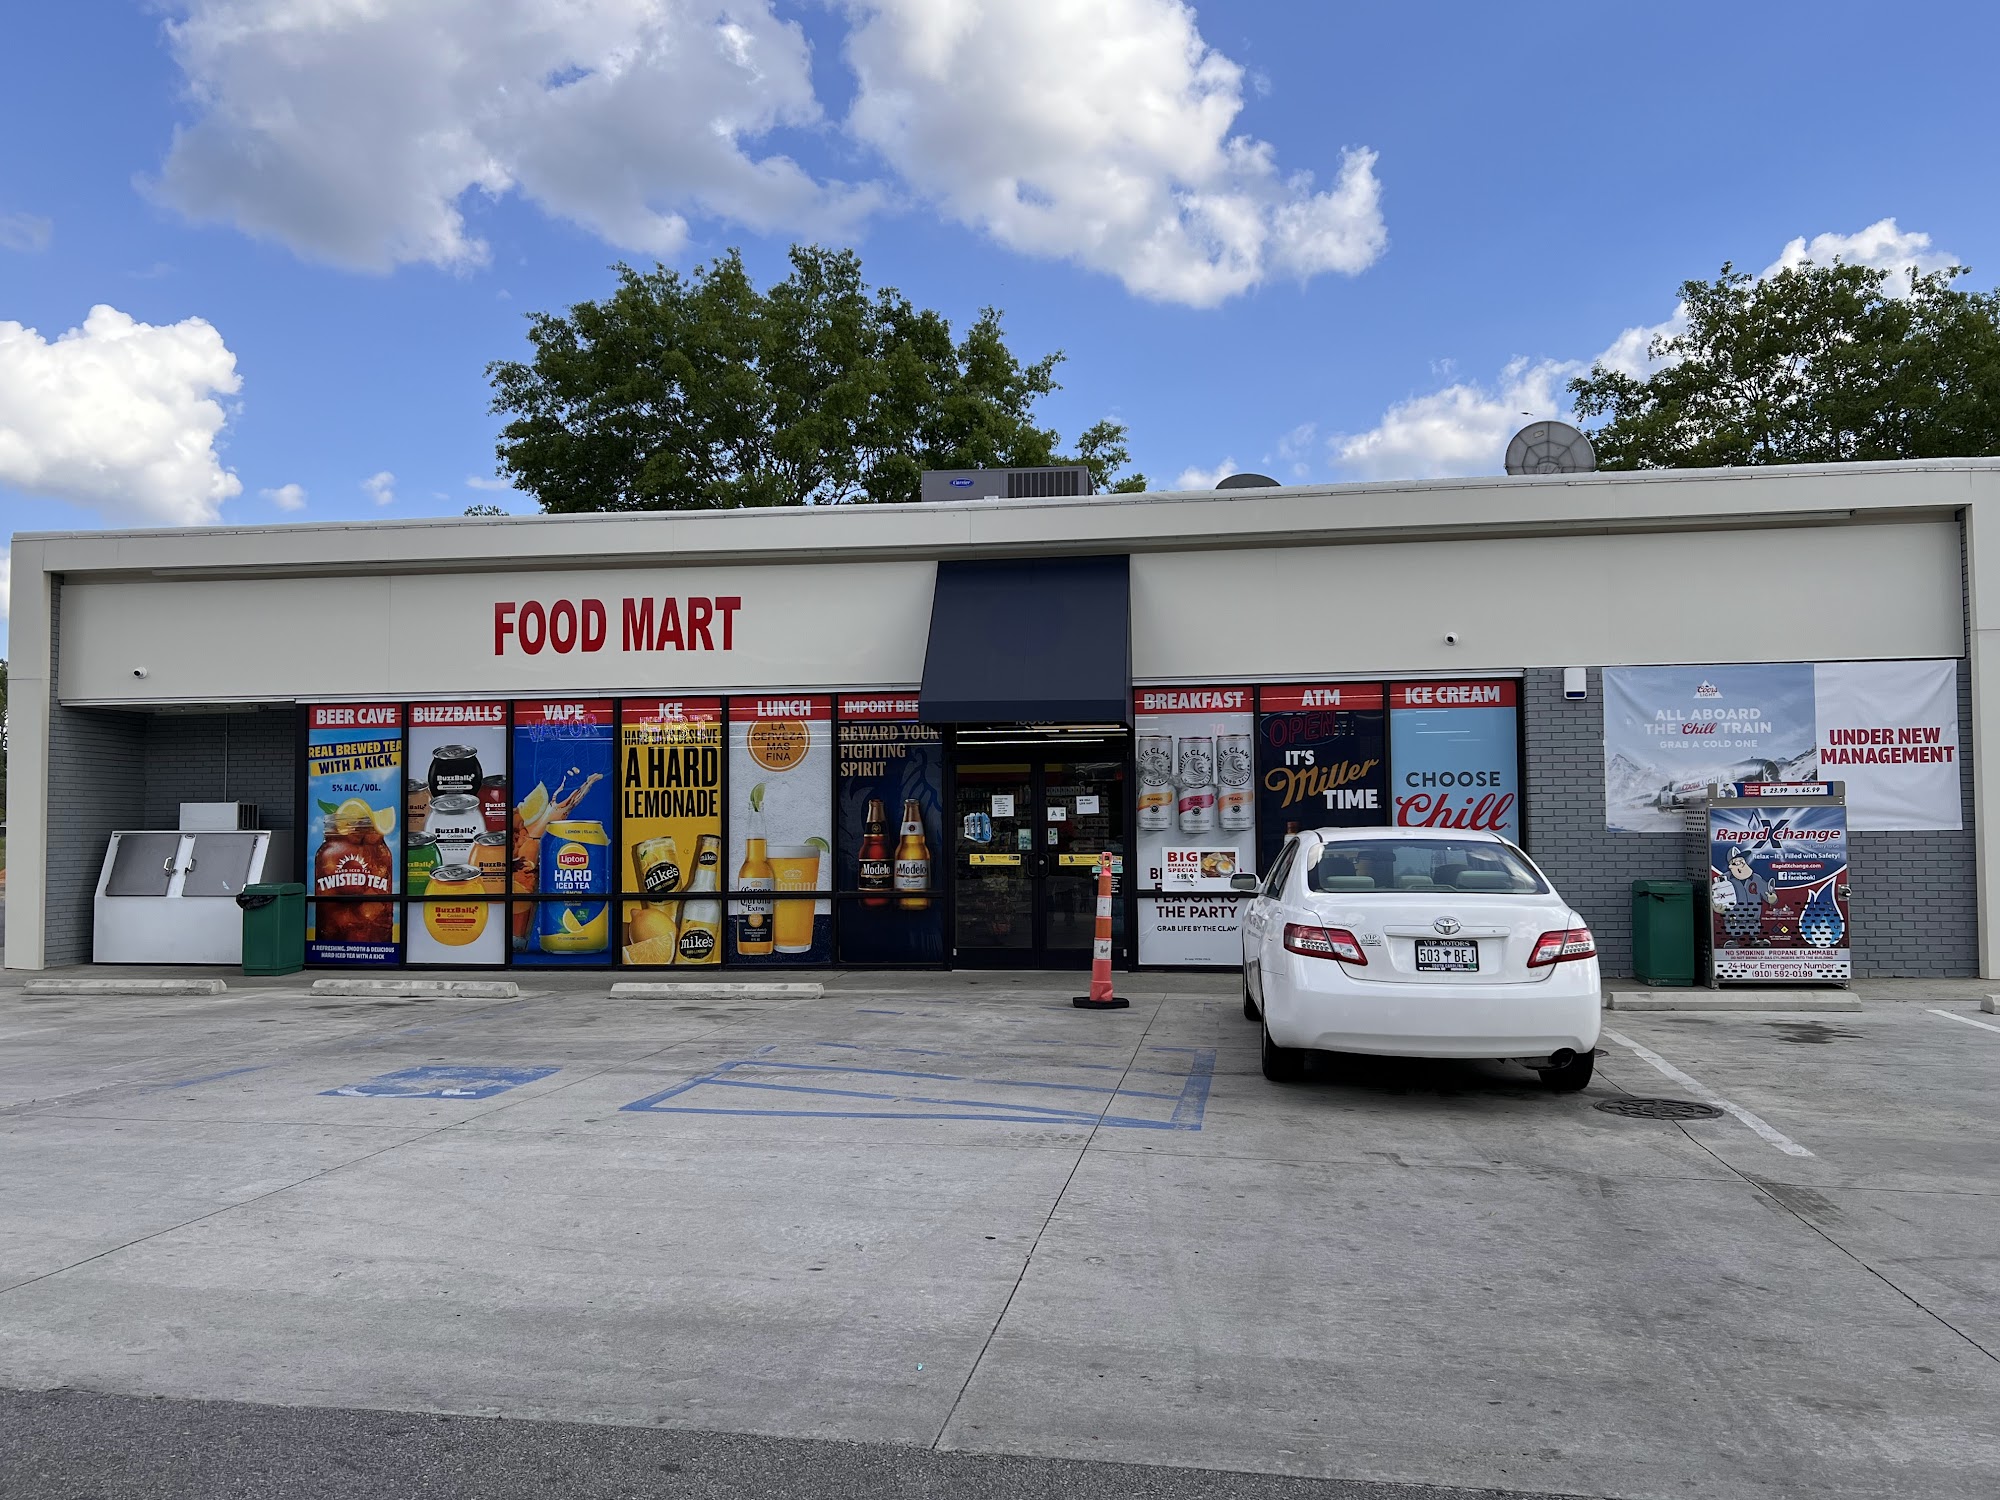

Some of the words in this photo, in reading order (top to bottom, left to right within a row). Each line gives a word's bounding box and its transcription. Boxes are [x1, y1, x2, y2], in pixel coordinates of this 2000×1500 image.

[494, 598, 607, 656] FOOD
[622, 596, 742, 652] MART
[1144, 692, 1244, 710] BREAKFAST
[1302, 689, 1340, 706] ATM
[1405, 686, 1434, 704] ICE
[1436, 686, 1500, 703] CREAM
[414, 706, 502, 722] BUZZBALLS
[543, 704, 584, 720] VAPE
[658, 702, 683, 718] ICE
[757, 700, 811, 716] LUNCH
[844, 700, 894, 714] IMPORT
[896, 700, 918, 712] BEE
[1655, 710, 1685, 721] ALL
[1690, 708, 1761, 720] ABOARD
[316, 708, 354, 724] BEER
[357, 708, 396, 724] CAVE
[840, 726, 898, 740] REWARD
[902, 725, 940, 740] YOUR
[1270, 711, 1336, 747] OPEN
[1644, 724, 1676, 734] THE
[1682, 722, 1717, 734] Chill
[1722, 722, 1772, 734] TRAIN
[624, 730, 650, 745] HARD
[652, 730, 676, 744] DAYS
[1830, 728, 1894, 746] UNDER
[1898, 727, 1940, 744] NEW
[308, 746, 334, 758] REAL
[336, 742, 381, 756] BREWED
[383, 740, 402, 752] TEA
[840, 744, 906, 758] FIGHTING
[1150, 748, 1170, 760] CLAW
[1191, 749, 1211, 762] CLAW
[1229, 747, 1250, 759] CLAW
[1820, 746, 1954, 765] MANAGEMENT
[319, 760, 350, 774] WITH
[354, 758, 362, 770] A
[365, 754, 397, 768] KICK.
[1286, 750, 1314, 765] IT'S
[625, 747, 642, 788] A
[647, 746, 718, 788] HARD
[840, 762, 886, 776] SPIRIT
[1264, 758, 1380, 808] Miller
[1406, 771, 1501, 788] CHOOSE
[344, 784, 381, 793] ALC./VOL.
[624, 789, 718, 818] LEMONADE
[1395, 792, 1515, 831] Chill
[561, 856, 584, 864] Lipton
[1168, 852, 1198, 862] BIG
[554, 870, 592, 882] HARD
[863, 864, 890, 874] Modelo
[899, 864, 927, 874] Modelo
[318, 873, 366, 892] TWISTED
[368, 874, 388, 892] TEA
[645, 866, 679, 890] mike's
[1156, 906, 1185, 918] THE
[1190, 906, 1238, 918] PARTY
[680, 936, 714, 949] mike's
[1420, 949, 1440, 962] 503
[1454, 950, 1475, 962] BEJ
